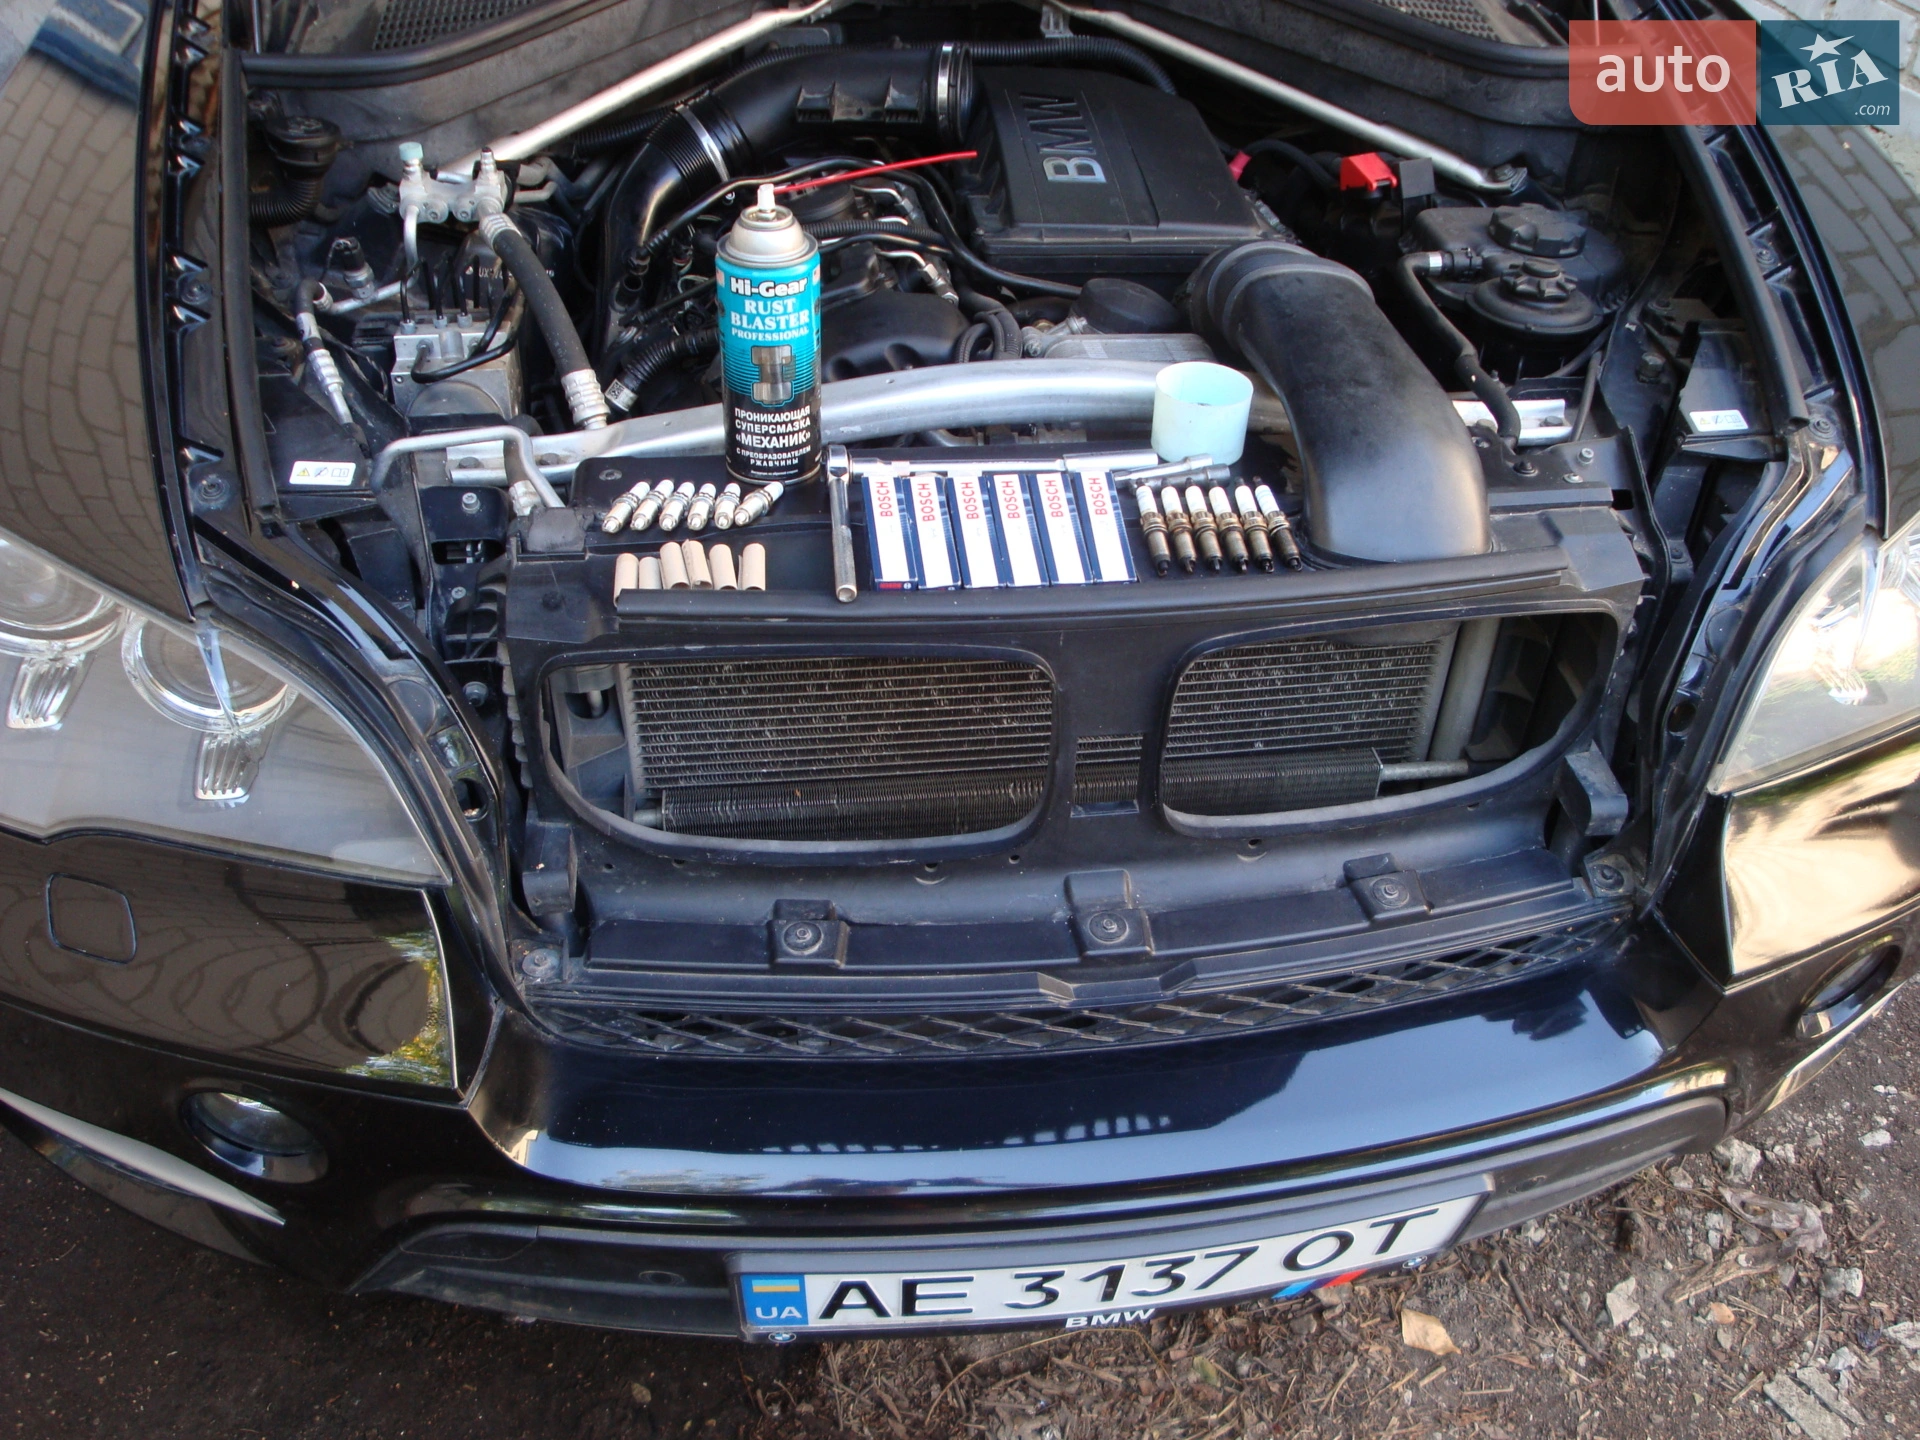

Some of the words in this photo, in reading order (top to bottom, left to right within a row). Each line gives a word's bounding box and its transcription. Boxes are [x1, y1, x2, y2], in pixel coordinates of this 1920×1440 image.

[1019, 93, 1107, 183] BMW
[730, 276, 808, 298] Hi-Gear
[744, 298, 796, 315] RUST
[730, 310, 809, 330] BLASTER
[731, 326, 809, 341] PROFESSIONAL
[734, 405, 810, 422] ПРОНИКАЮЩАЯ
[735, 417, 811, 434] СУПЕРСМАЗКА
[736, 430, 811, 448] «МЕХАНИК»
[741, 445, 811, 460] ПРЕОБРАЗОВАТЕЛЕМ
[750, 458, 799, 467] РЖАВЧИНЫ
[876, 481, 893, 517] BOSCH
[917, 483, 936, 522] BOSCH
[961, 482, 979, 519] BOSCH
[1001, 480, 1020, 519] BOSCH
[1044, 480, 1064, 518] BOSCH
[1088, 477, 1108, 516] BOSCH
[818, 1276, 974, 1319] AE
[1003, 1245, 1260, 1309] 3137
[1282, 1207, 1439, 1272] OT
[755, 1305, 803, 1320] UA
[1065, 1308, 1155, 1329] BMW
